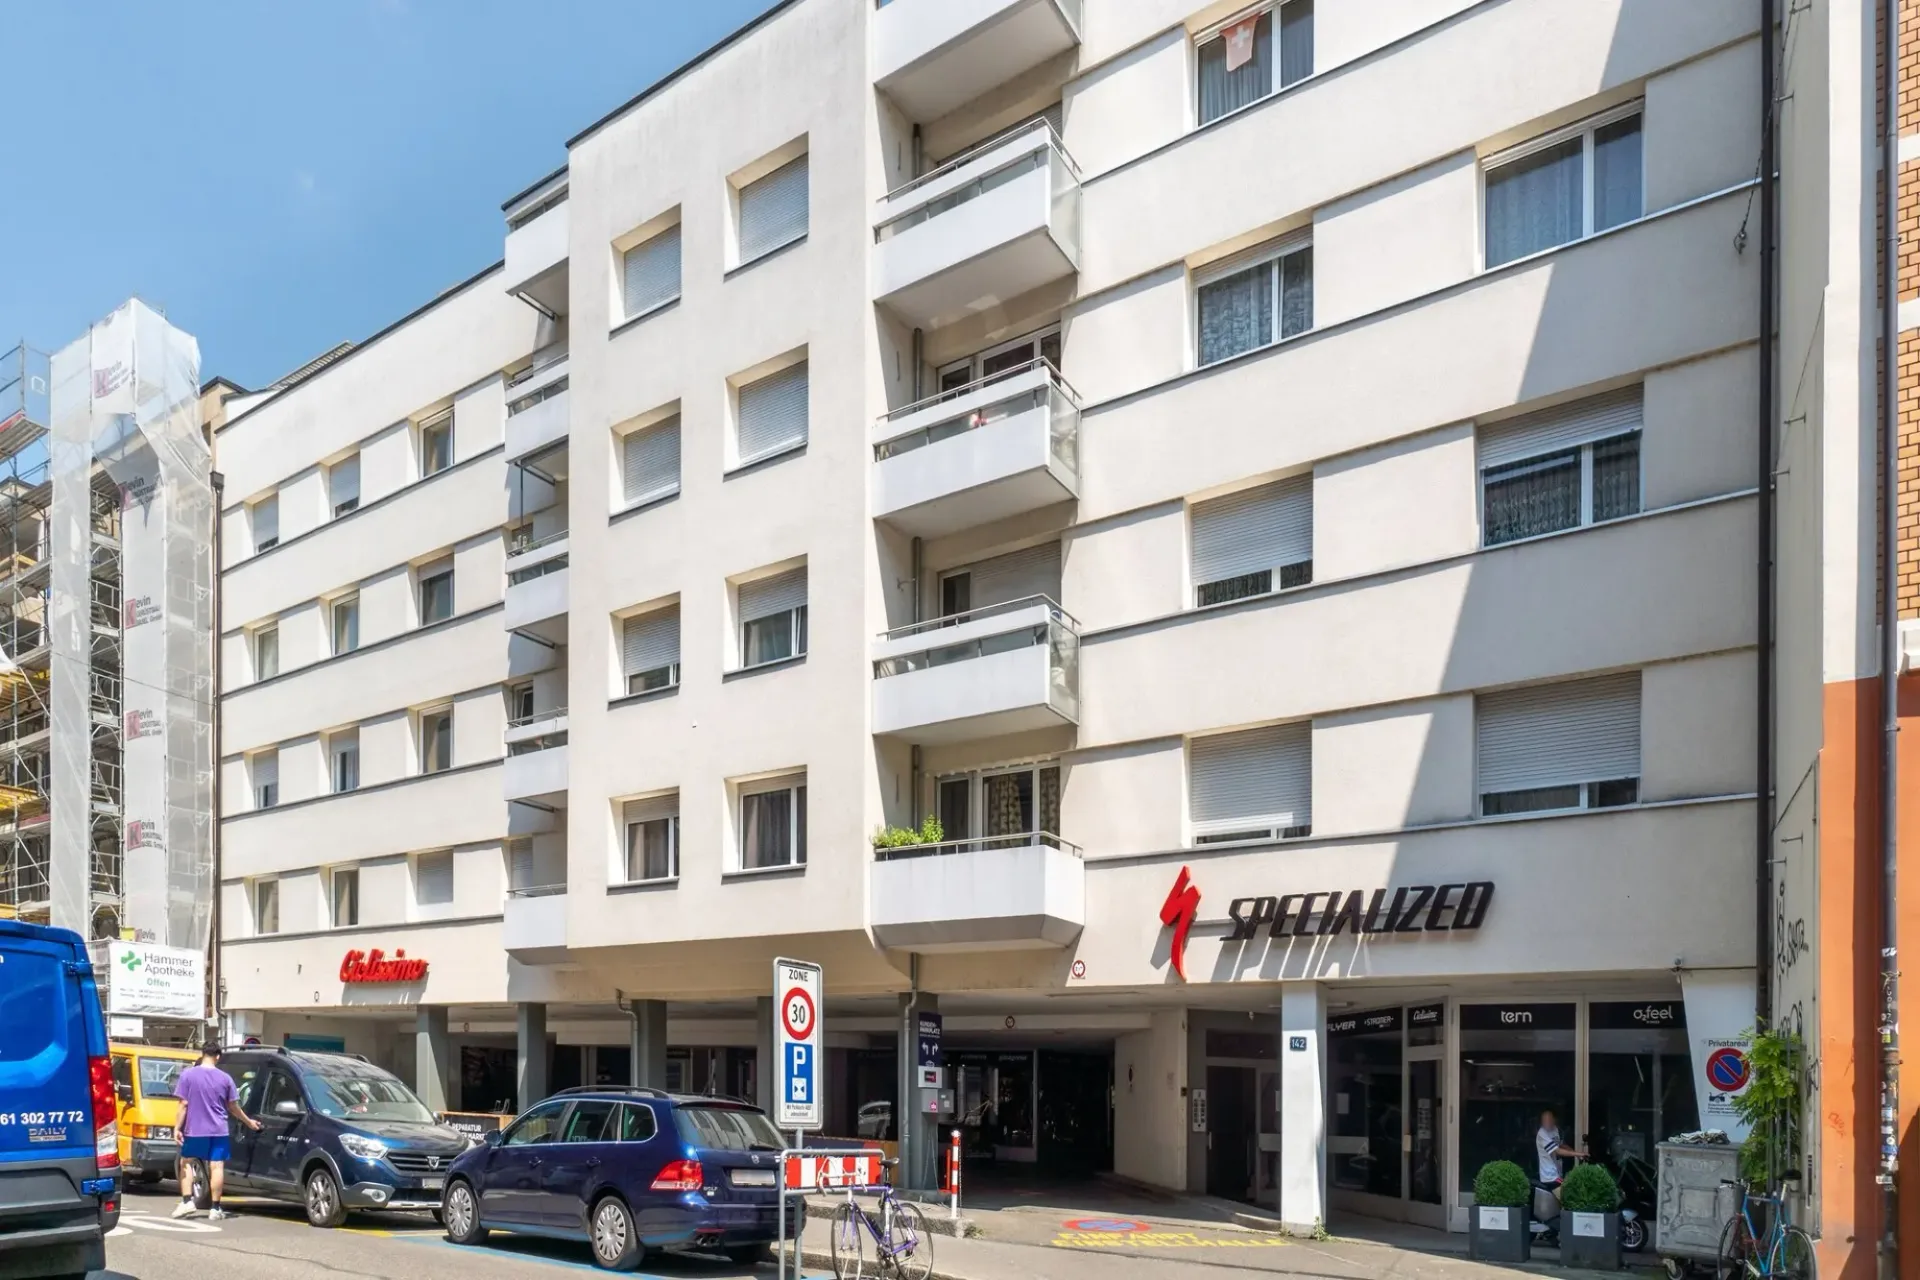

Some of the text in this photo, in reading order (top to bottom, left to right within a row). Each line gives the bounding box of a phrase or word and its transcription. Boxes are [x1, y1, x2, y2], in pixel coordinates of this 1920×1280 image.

[1220, 881, 1496, 941] SPECIALIZED
[144, 952, 193, 967] Hammer
[144, 964, 195, 978] Apotheke
[788, 969, 808, 981] ZONE
[791, 1003, 806, 1024] 30
[1501, 1011, 1532, 1023] tern
[1291, 1038, 1306, 1049] 142
[793, 1046, 806, 1076] P
[20, 1112, 46, 1125] 302
[48, 1111, 65, 1123] 77
[67, 1110, 84, 1123] 72
[28, 1127, 67, 1136] DAILY
